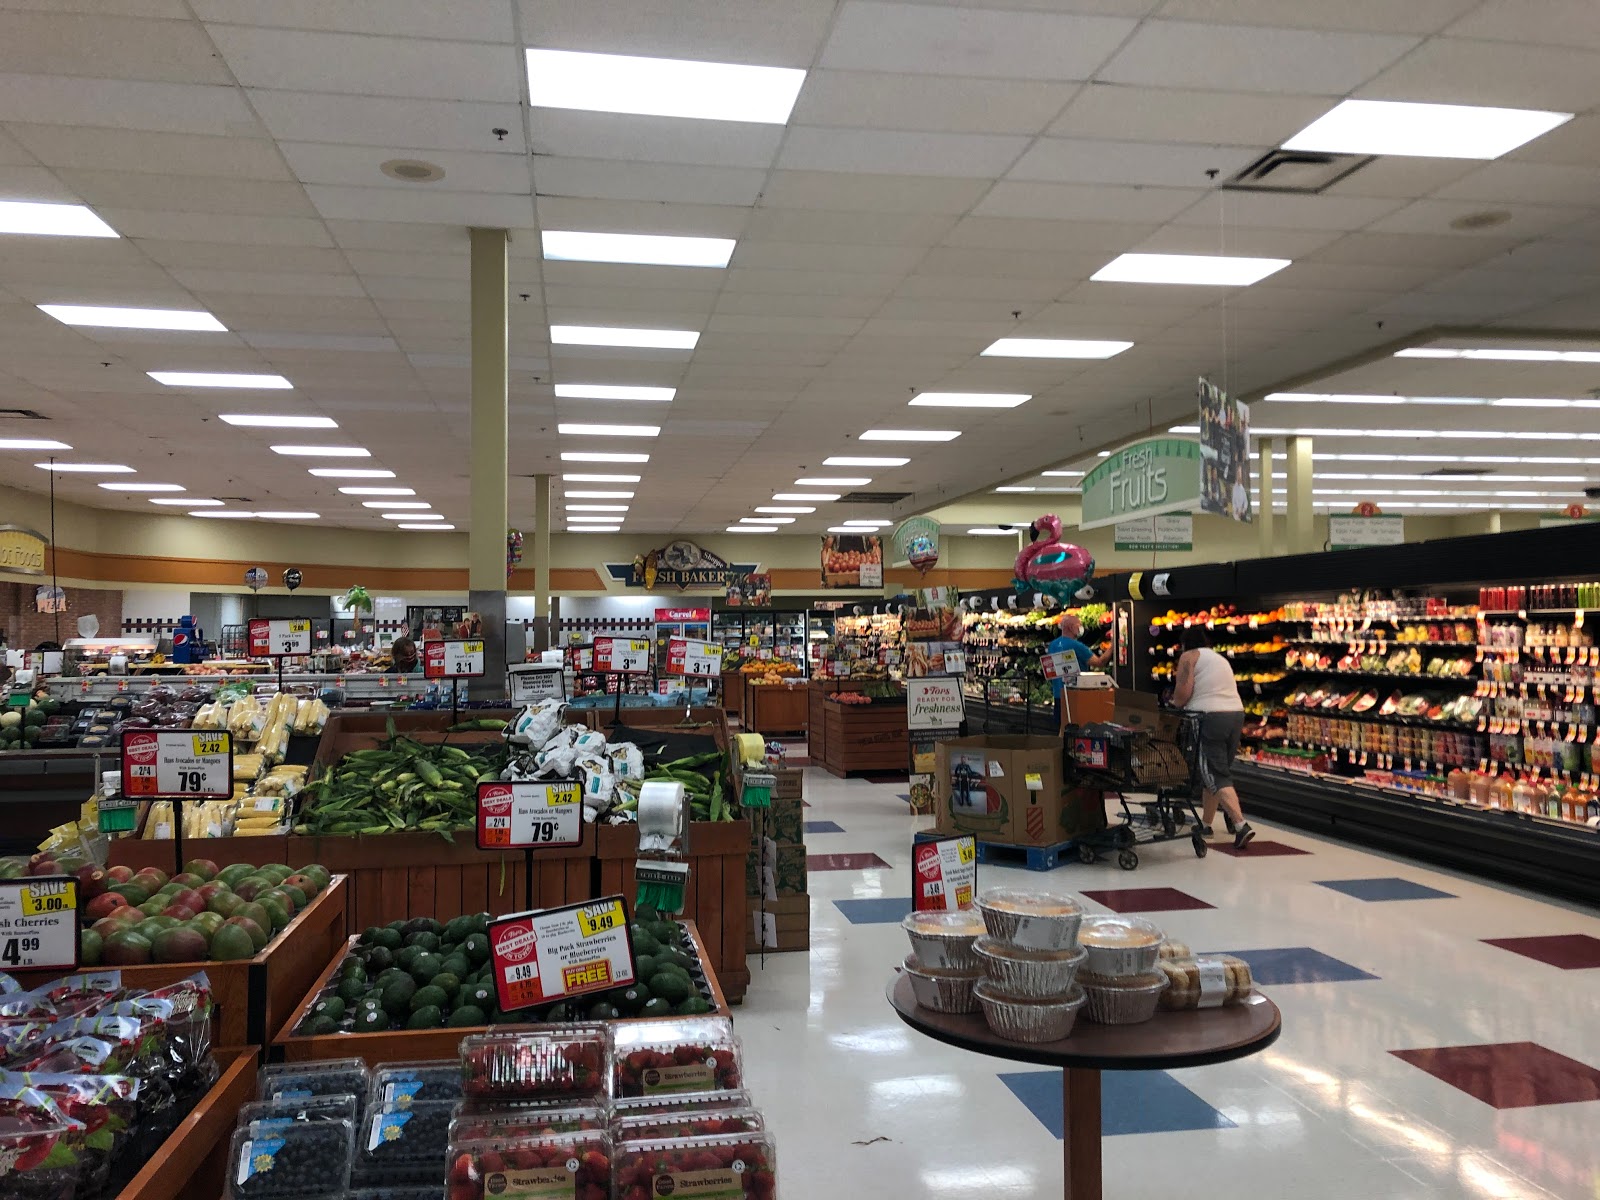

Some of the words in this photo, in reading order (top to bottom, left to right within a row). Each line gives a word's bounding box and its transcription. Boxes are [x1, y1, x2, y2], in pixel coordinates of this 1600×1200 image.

[1122, 446, 1154, 471] Fresh
[1110, 466, 1168, 514] Fruits
[704, 552, 724, 568] Shoppe
[632, 571, 676, 582] FSH
[913, 702, 960, 716] freshness
[198, 733, 224, 742] SAVE
[202, 757, 220, 765] Mangoes
[552, 783, 576, 793] SAVE
[532, 822, 559, 842] 79¢
[30, 882, 67, 898] SAVE
[32, 898, 62, 911] $3.00
[583, 901, 616, 918] SAVE
[15, 918, 59, 927] Cherries
[587, 916, 613, 931] $9.49
[498, 943, 513, 952] BEST
[515, 935, 534, 946] DEALS
[559, 943, 574, 952] Pack
[576, 935, 617, 948] Strawberries
[570, 946, 606, 958] Blueberries
[515, 965, 531, 979] 9.49
[567, 968, 608, 987] FREE
[664, 1071, 706, 1080] Strawberries
[680, 1177, 732, 1188] Strawberries
